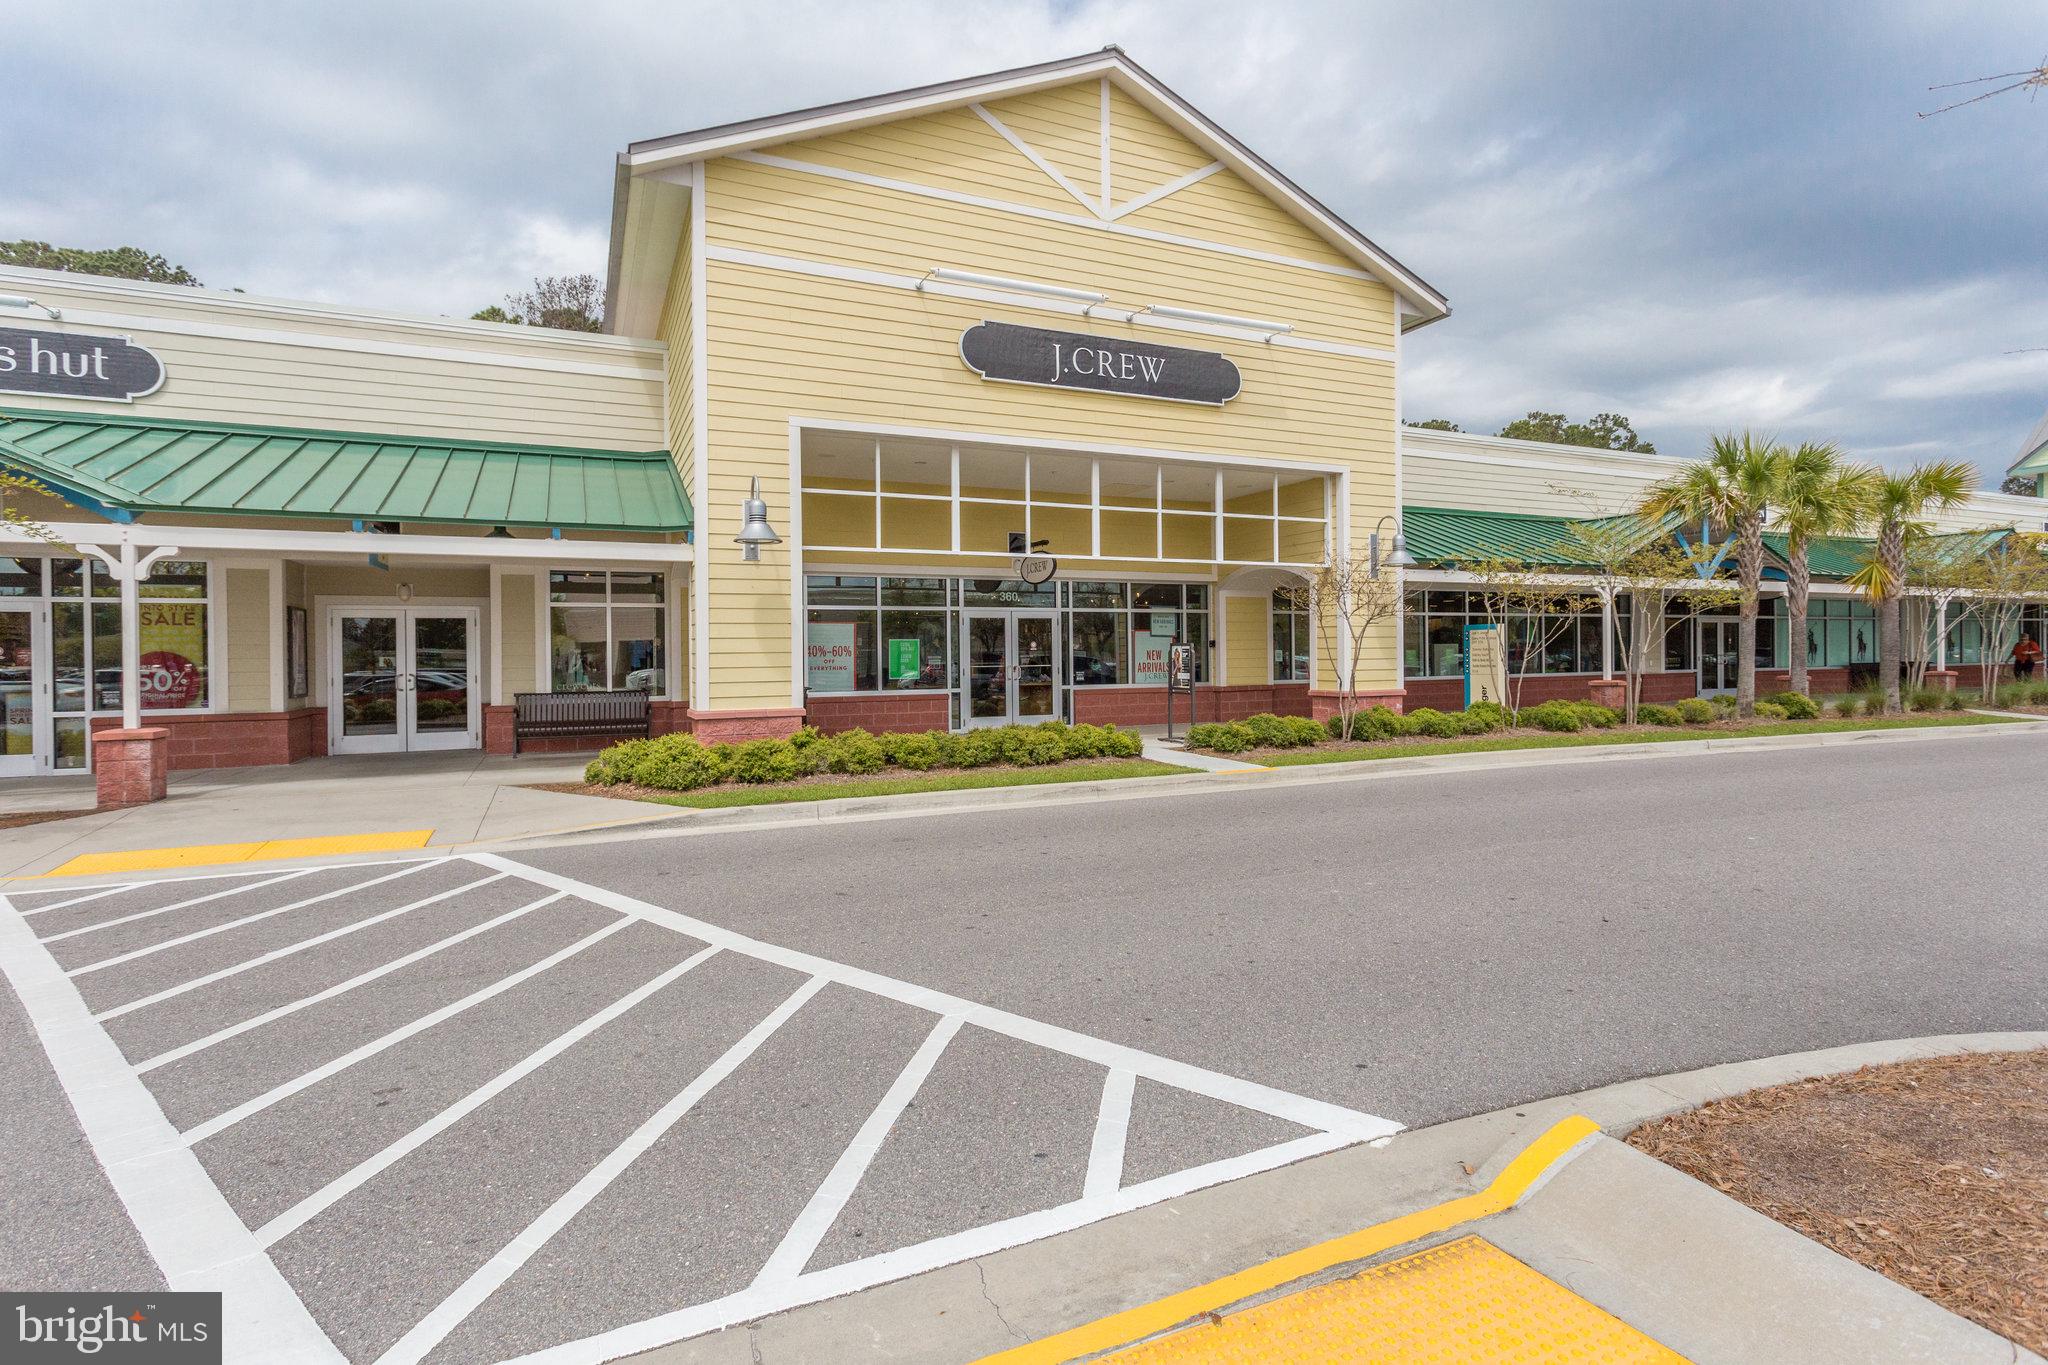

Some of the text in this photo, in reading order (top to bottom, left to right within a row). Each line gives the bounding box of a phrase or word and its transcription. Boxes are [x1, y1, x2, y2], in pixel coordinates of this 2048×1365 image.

[31, 338, 110, 380] hut
[1051, 344, 1166, 383] J.CREW
[1000, 592, 1018, 601] 360
[141, 612, 196, 627] SALE
[1147, 650, 1161, 660] NEW
[1138, 662, 1169, 672] ARRIVALS
[140, 671, 188, 692] 50%
